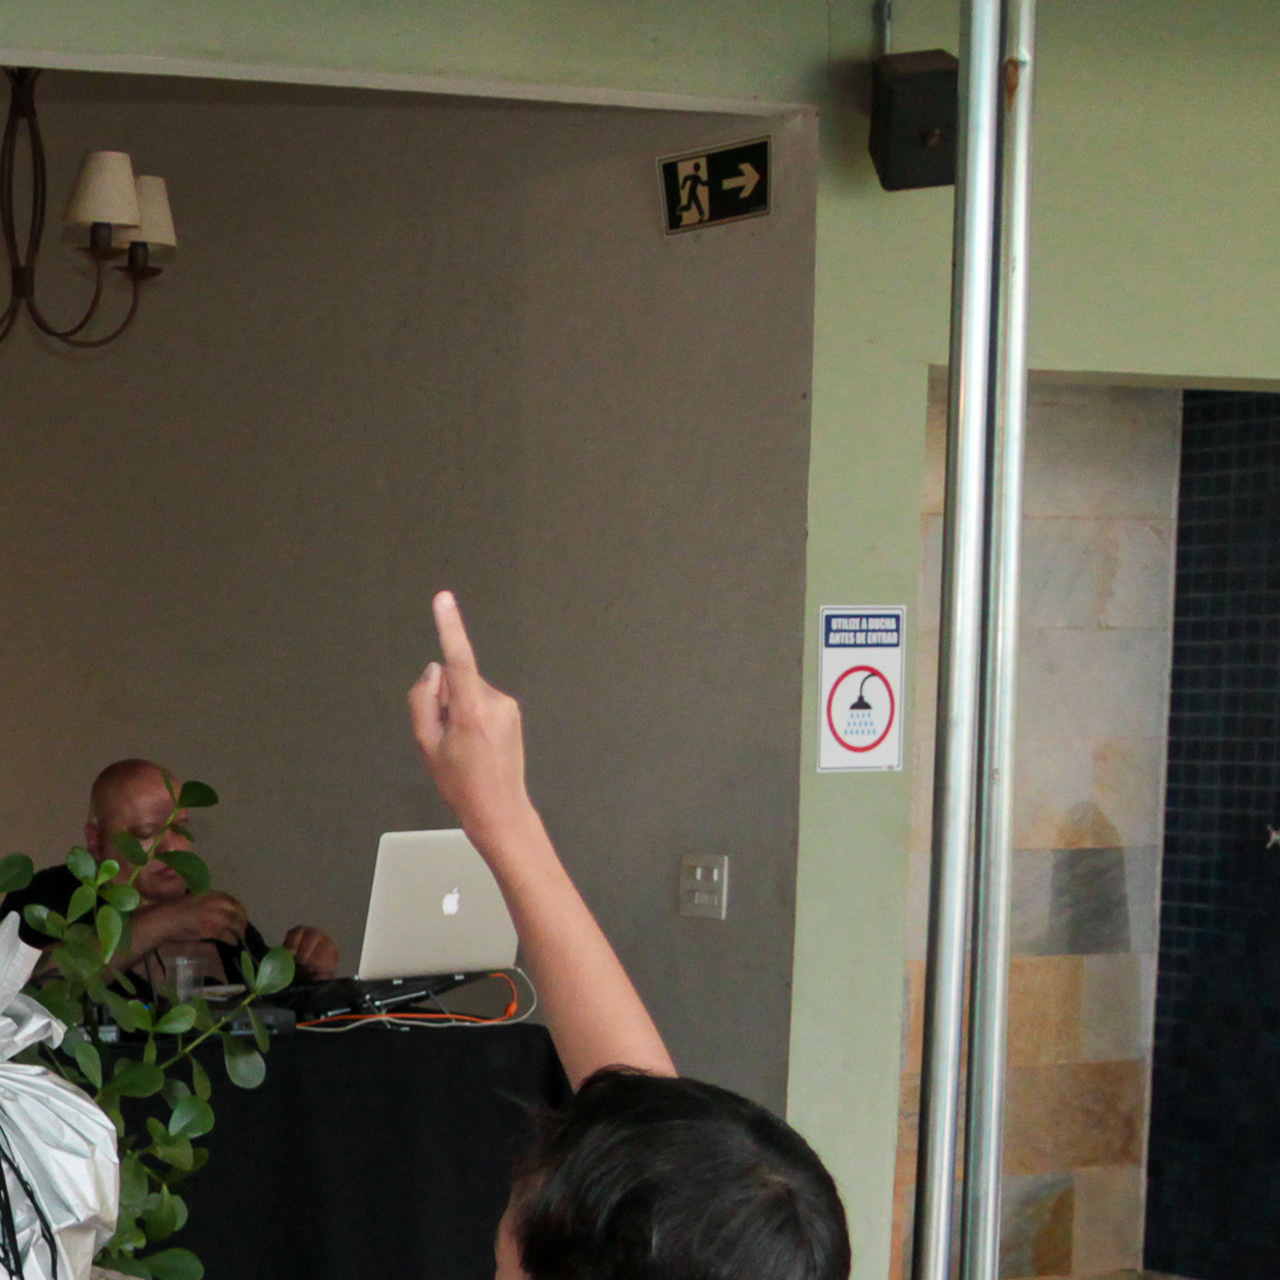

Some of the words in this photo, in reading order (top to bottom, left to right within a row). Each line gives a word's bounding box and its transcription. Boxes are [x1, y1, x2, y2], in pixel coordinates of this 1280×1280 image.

[831, 617, 860, 630] UTILIZE
[861, 617, 867, 630] A
[868, 617, 896, 630] DUCHA
[829, 632, 854, 644] ANTES
[855, 632, 866, 644] DE
[867, 632, 898, 644] ENTRAR
